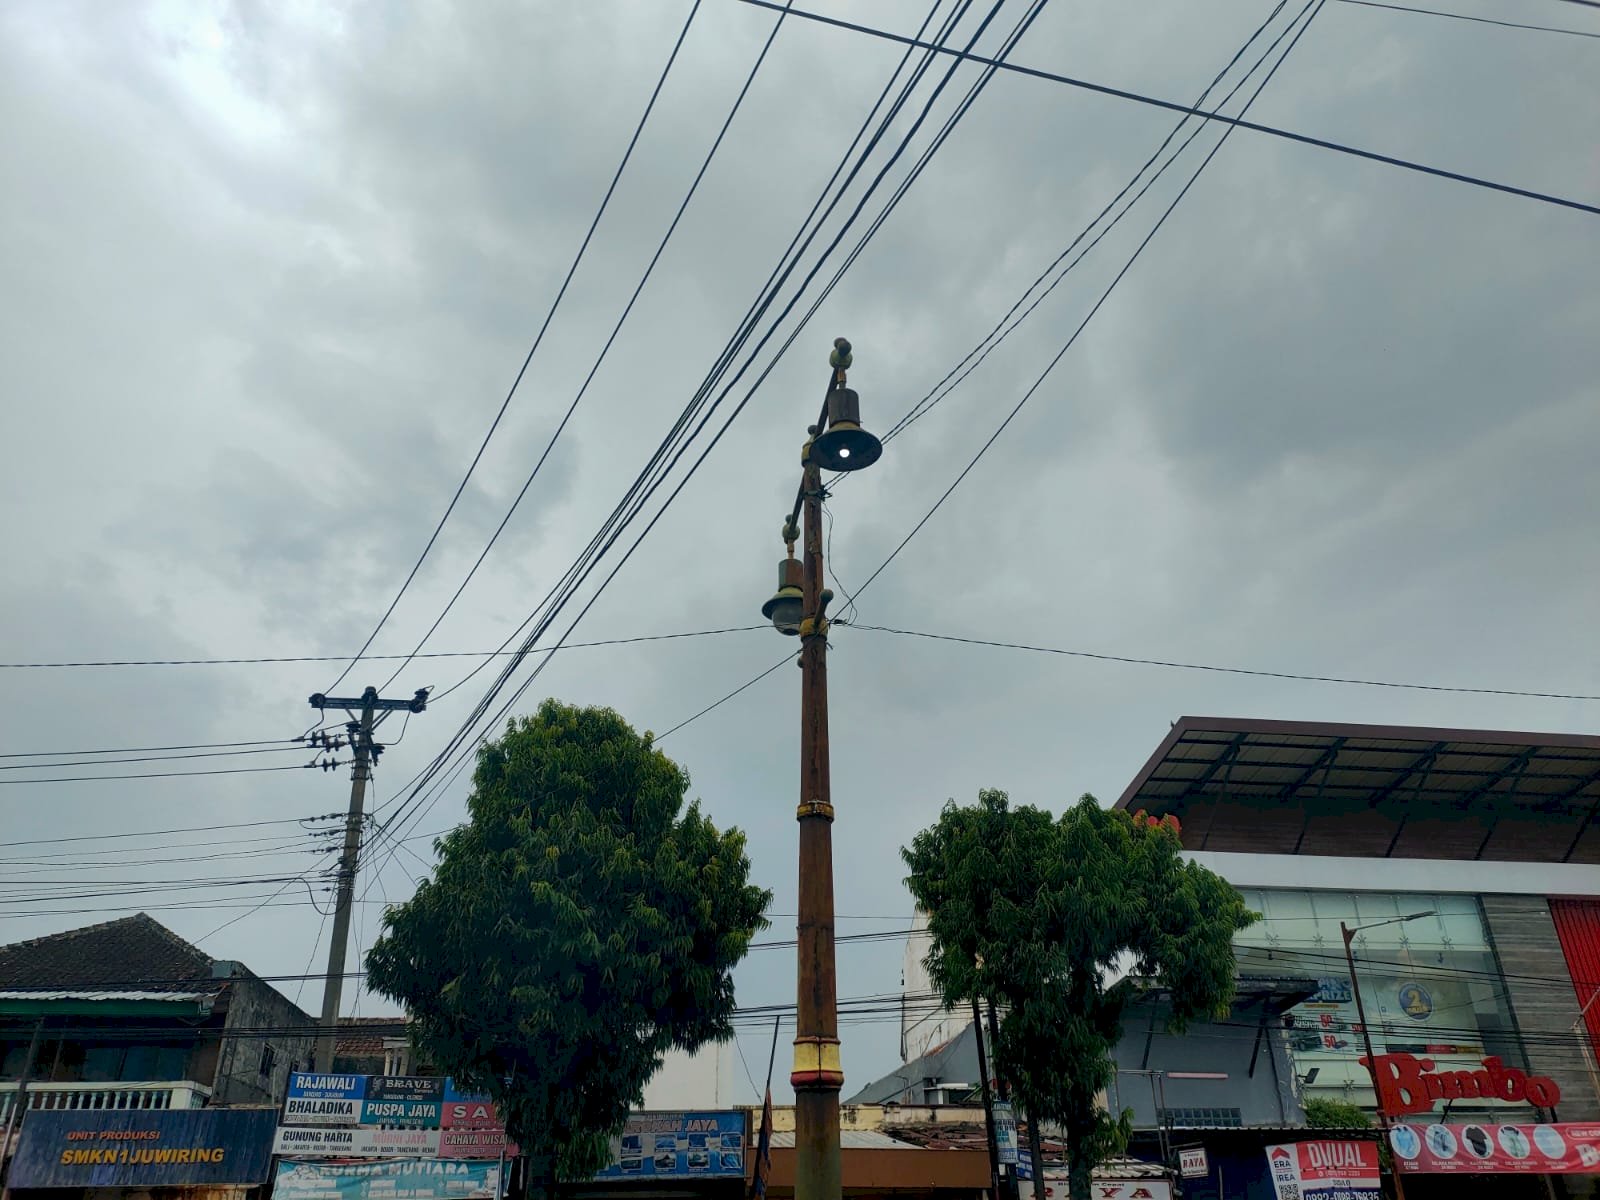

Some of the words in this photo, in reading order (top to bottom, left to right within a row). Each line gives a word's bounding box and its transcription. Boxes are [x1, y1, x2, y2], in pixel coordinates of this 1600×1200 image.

[296, 1076, 355, 1090] RAJAWALI
[386, 1079, 431, 1089] BRAVE
[1359, 1052, 1560, 1116] Bimbo
[288, 1100, 352, 1115] BHALADIKA
[366, 1103, 404, 1117] PUSPA
[408, 1105, 435, 1118] JAYA
[686, 1120, 718, 1132] JAYA
[67, 1132, 96, 1141] UNIT
[99, 1131, 161, 1141] PRODUKSI
[283, 1131, 321, 1142] GUNUNG
[324, 1132, 352, 1143] HARTA
[406, 1134, 426, 1145] JAYA
[445, 1134, 479, 1145] CAHAYA
[60, 1150, 118, 1165] SMKN
[119, 1150, 130, 1164] 1
[130, 1148, 225, 1164] JUWIRING
[388, 1163, 469, 1176] MUTIARA
[1274, 1160, 1291, 1168] ERA
